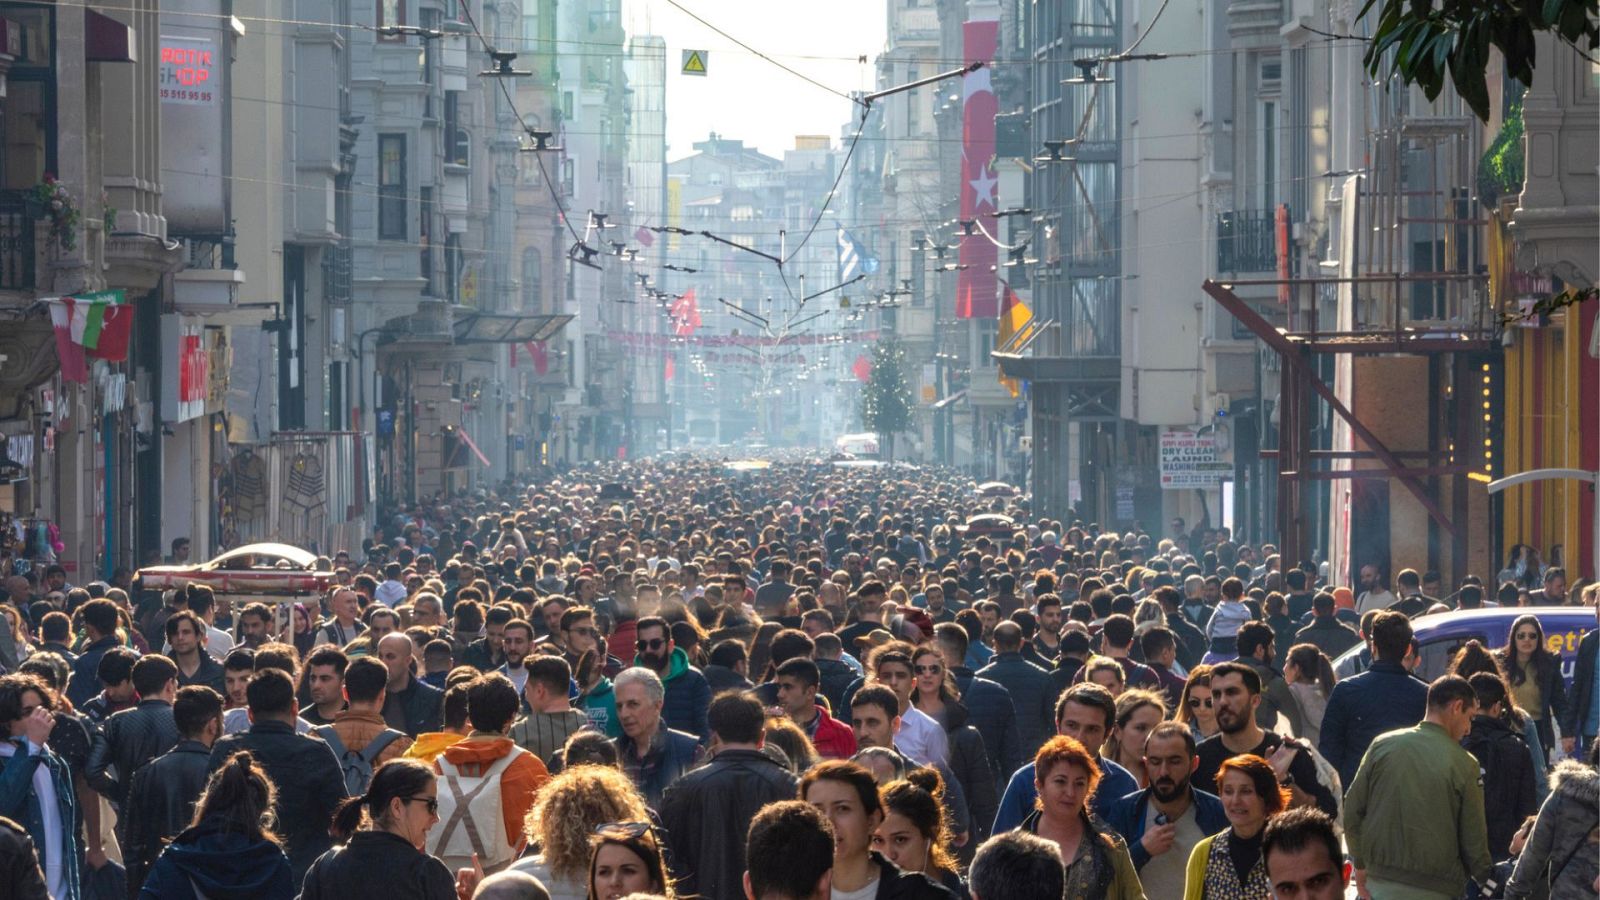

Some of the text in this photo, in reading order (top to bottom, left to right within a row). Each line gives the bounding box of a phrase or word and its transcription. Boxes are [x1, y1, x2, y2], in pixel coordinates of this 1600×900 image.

[171, 89, 186, 99] 515
[188, 91, 199, 100] 95
[201, 92, 212, 101] 95
[1162, 447, 1181, 455] DRY
